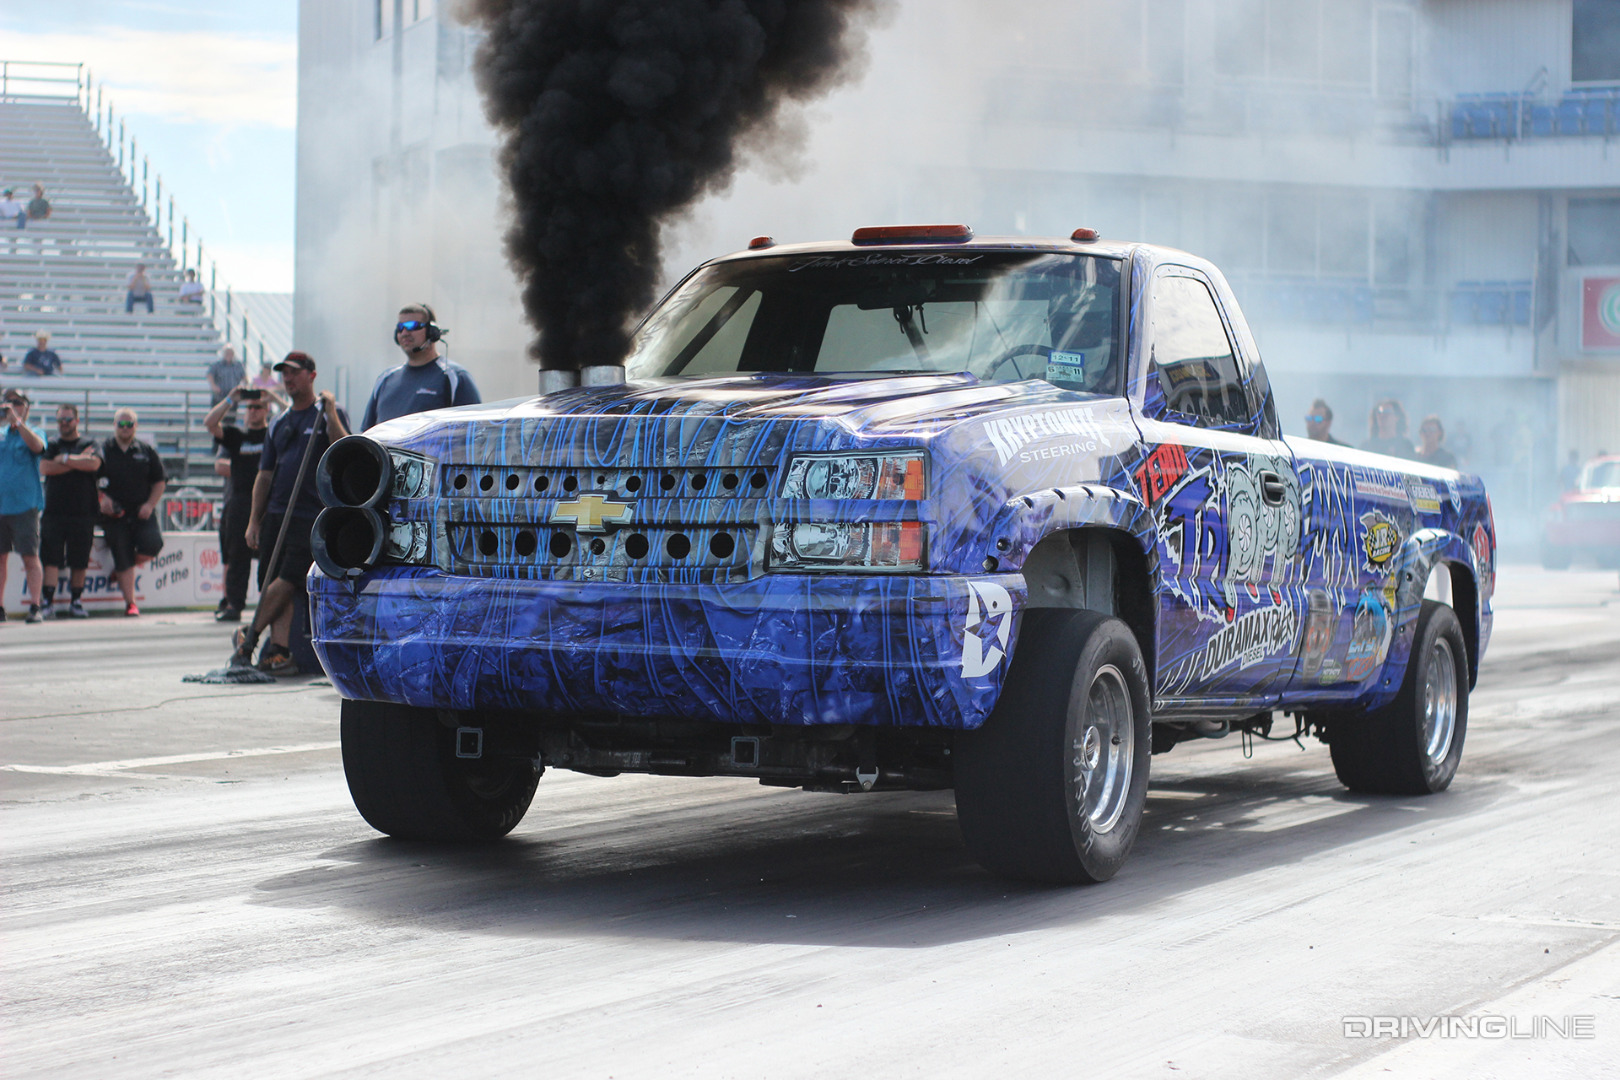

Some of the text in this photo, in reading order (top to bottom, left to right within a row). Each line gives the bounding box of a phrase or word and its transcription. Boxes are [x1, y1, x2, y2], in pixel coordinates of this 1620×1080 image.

[982, 406, 1112, 468] KRYPTONITE
[1019, 440, 1097, 464] STEERING
[151, 550, 183, 571] Home
[155, 572, 168, 590] of
[171, 568, 189, 584] the
[1201, 606, 1271, 681] DURAMAX
[1241, 646, 1264, 668] DIESEL
